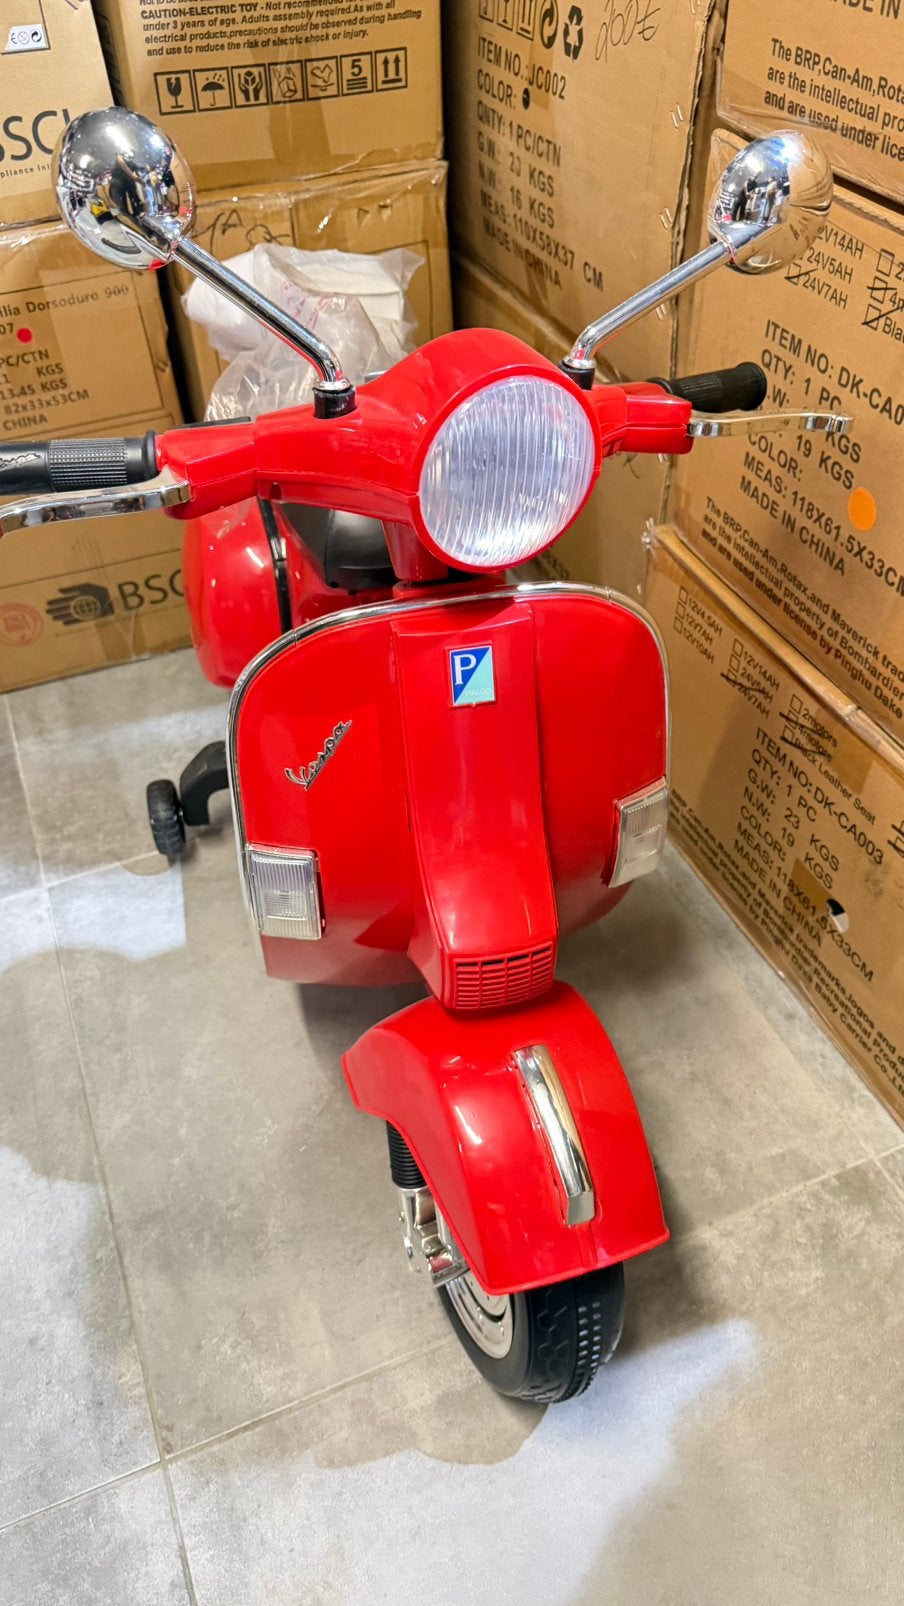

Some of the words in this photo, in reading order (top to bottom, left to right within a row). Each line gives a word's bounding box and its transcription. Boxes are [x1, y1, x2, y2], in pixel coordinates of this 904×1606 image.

[140, 4, 237, 20] CAUTION-ELECTRIC
[239, 2, 259, 13] TOY
[265, 1, 282, 11] Not
[143, 21, 171, 32] under
[172, 19, 178, 30] 3
[180, 18, 205, 31] years
[208, 17, 217, 27] of
[241, 13, 270, 25] Adults
[272, 9, 314, 22] assembly
[365, 2, 383, 12] with
[385, 0, 396, 9] all
[144, 32, 187, 44] electrical
[280, 22, 309, 34] should
[309, 20, 320, 31] be
[321, 16, 357, 29] observed
[358, 13, 386, 25] during
[387, 9, 422, 21] handling
[146, 46, 164, 57] and
[166, 45, 182, 55] use
[184, 44, 193, 54] to
[195, 41, 225, 53] reduce
[227, 39, 241, 50] the
[243, 37, 259, 49] risk
[261, 36, 270, 47] of
[272, 33, 303, 46] electric
[304, 31, 330, 43] shock
[332, 31, 341, 40] or
[343, 27, 369, 40] injury.
[477, 35, 502, 69] ITEM
[771, 37, 792, 62] The
[476, 68, 517, 111] COLOR:
[767, 65, 786, 86] are
[788, 70, 807, 94] the
[808, 78, 880, 124] intellectual
[763, 90, 786, 112] and
[787, 100, 806, 119] are
[808, 108, 840, 134] used
[840, 120, 880, 150] under
[508, 121, 514, 142] 1
[516, 124, 562, 169] PC/CTN
[528, 163, 555, 199] KGS
[528, 196, 555, 230] KGS
[524, 247, 563, 291] CHINA
[582, 261, 604, 293] CM
[806, 246, 854, 284] 24V5AH
[25, 288, 99, 314] Dorsoduro
[802, 271, 849, 310] 24V7AH
[35, 362, 64, 378] KGS
[761, 348, 796, 386] QTY:
[803, 377, 812, 396] 1
[764, 319, 803, 358] ITEM
[804, 344, 834, 380] NO:
[4, 388, 90, 416] 82x33x53CM
[40, 377, 68, 393] KGS
[3, 413, 48, 431] CHINA
[743, 450, 788, 499] MEAS:
[795, 433, 813, 458] 19
[818, 450, 854, 490] KGS
[739, 474, 780, 520] MADE
[781, 510, 797, 534] IN
[798, 525, 846, 577] CHINA
[703, 513, 718, 532] are
[718, 525, 733, 545] the
[732, 538, 784, 591] intellectual
[783, 585, 827, 632] property
[826, 625, 839, 642] of
[706, 495, 722, 518] The
[831, 608, 880, 661] Maverick
[701, 528, 718, 549] and
[717, 544, 733, 563] are
[732, 556, 755, 583] used
[755, 577, 783, 608] under
[783, 602, 819, 642] license
[818, 634, 834, 656] by
[834, 648, 873, 693] Pinghu
[873, 684, 904, 720] Dake
[453, 653, 477, 685] P
[284, 719, 353, 792] Vespa
[752, 748, 782, 786] QTY:
[786, 784, 793, 798] 1
[797, 795, 818, 823] PC
[755, 727, 787, 768] ITEM
[787, 759, 813, 793] NO:
[812, 786, 884, 866] DK-CA003
[818, 761, 853, 801] Leather
[852, 797, 876, 826] Seat
[740, 805, 787, 862] COLOR:
[743, 786, 771, 823] N.W:
[780, 826, 796, 848] 19
[803, 850, 834, 890] KGS
[747, 768, 776, 805] G.W:
[783, 807, 801, 830] 23
[808, 832, 840, 873] KGS
[736, 822, 774, 870] MEAS:
[733, 838, 768, 884] MADE
[768, 878, 782, 899] IN
[782, 895, 822, 948] CHINA
